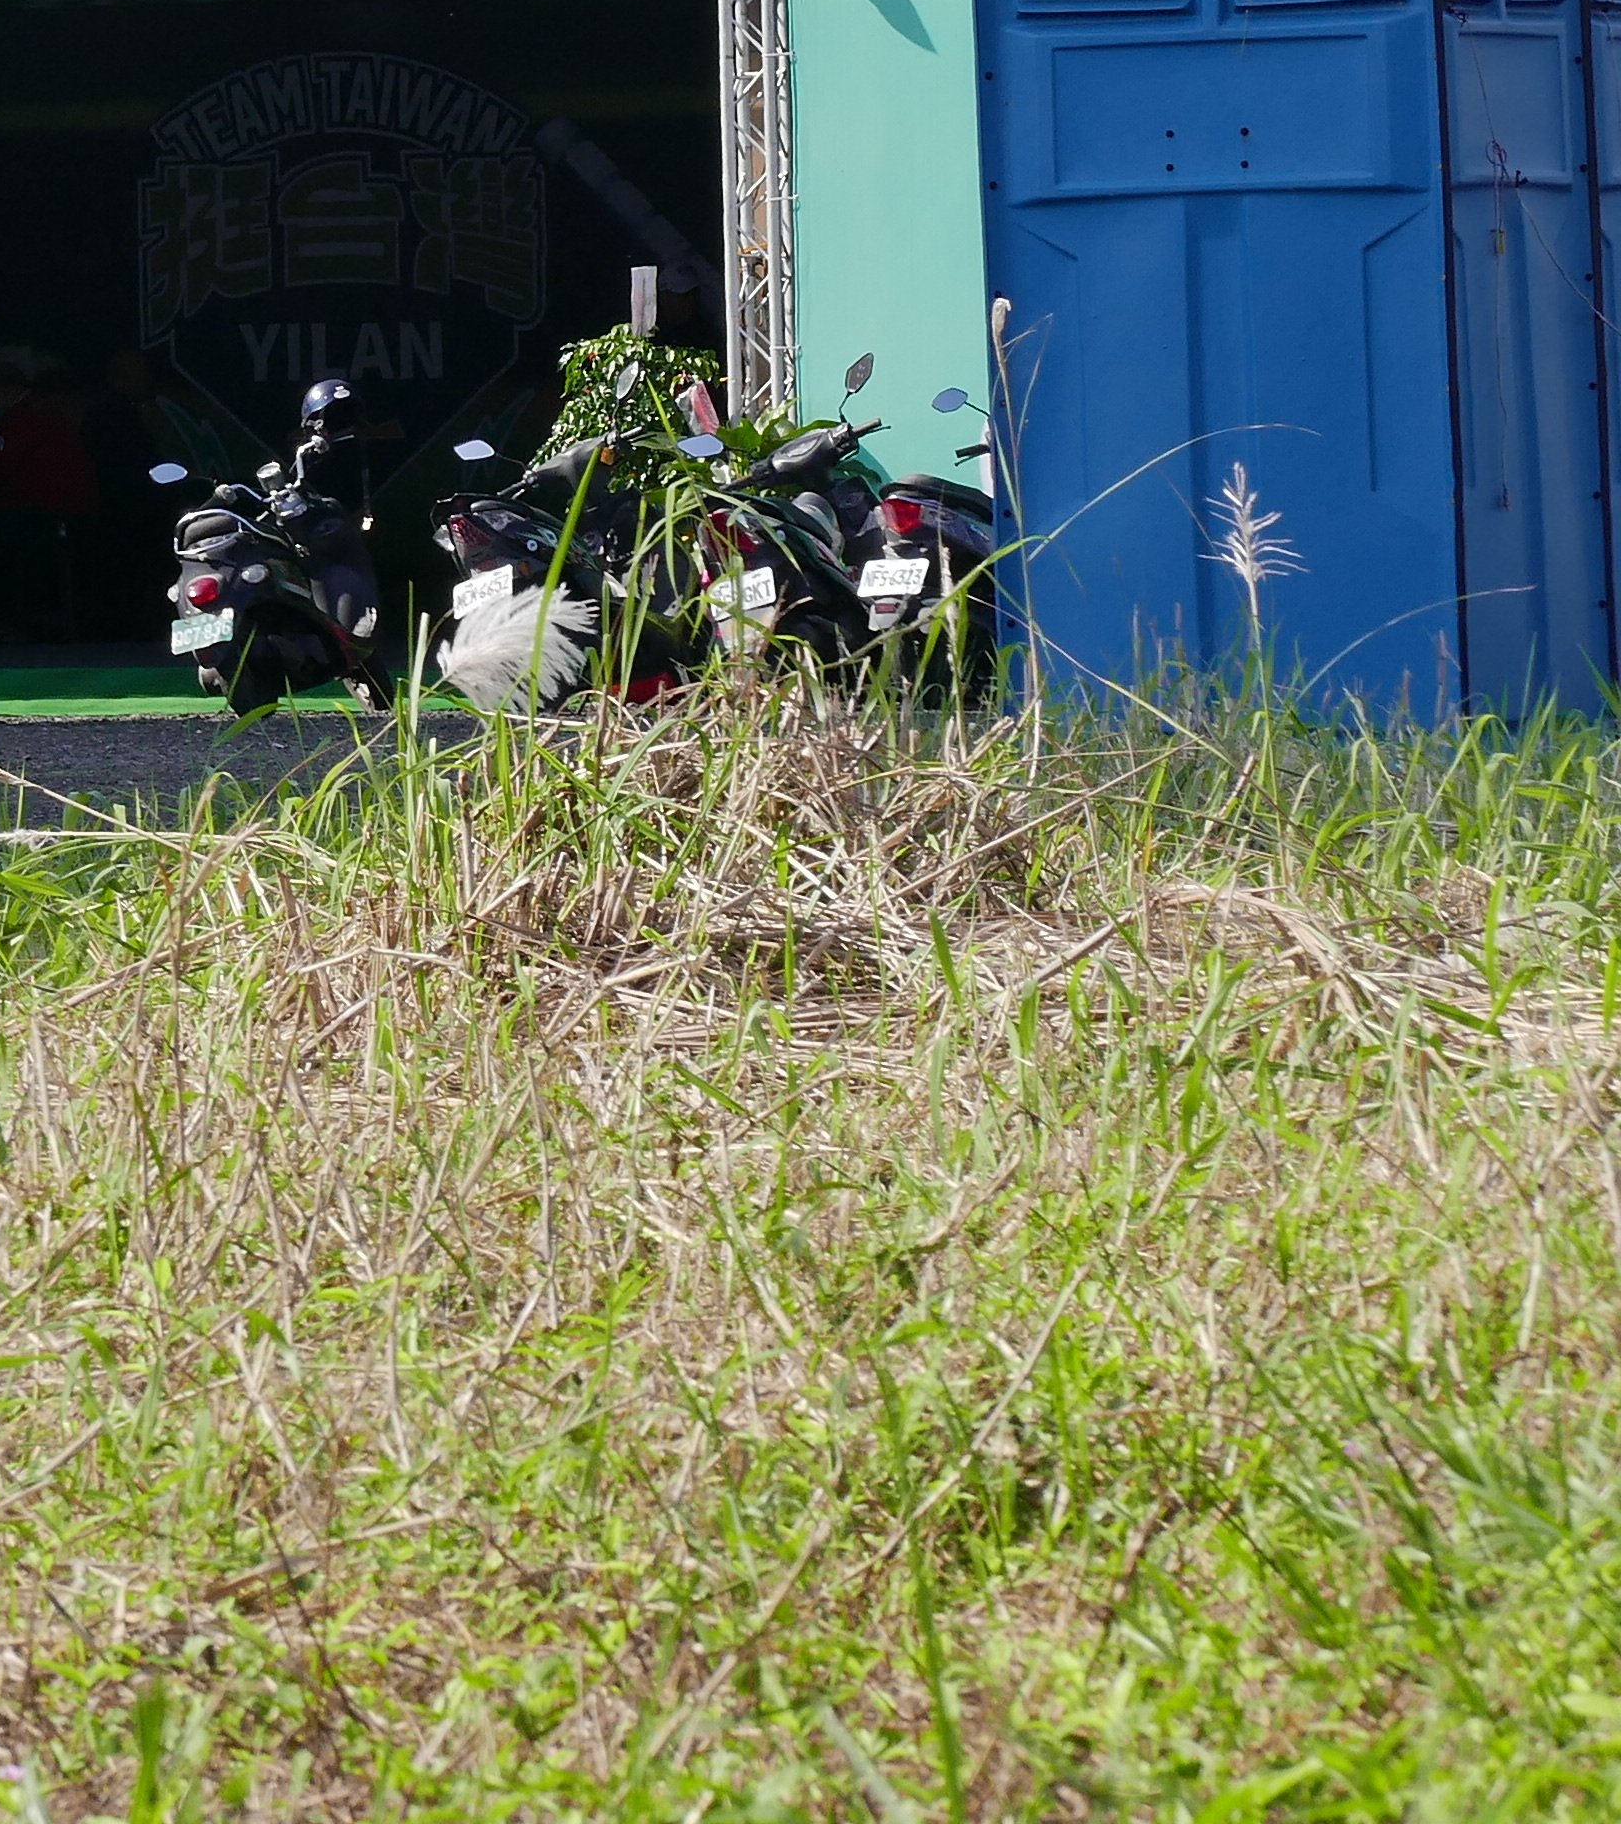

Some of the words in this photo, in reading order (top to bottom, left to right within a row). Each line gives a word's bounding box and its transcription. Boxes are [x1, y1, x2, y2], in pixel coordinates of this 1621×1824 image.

[159, 60, 312, 161] TEAM
[317, 60, 526, 154] TAIWAN
[239, 321, 445, 383] YILAN
